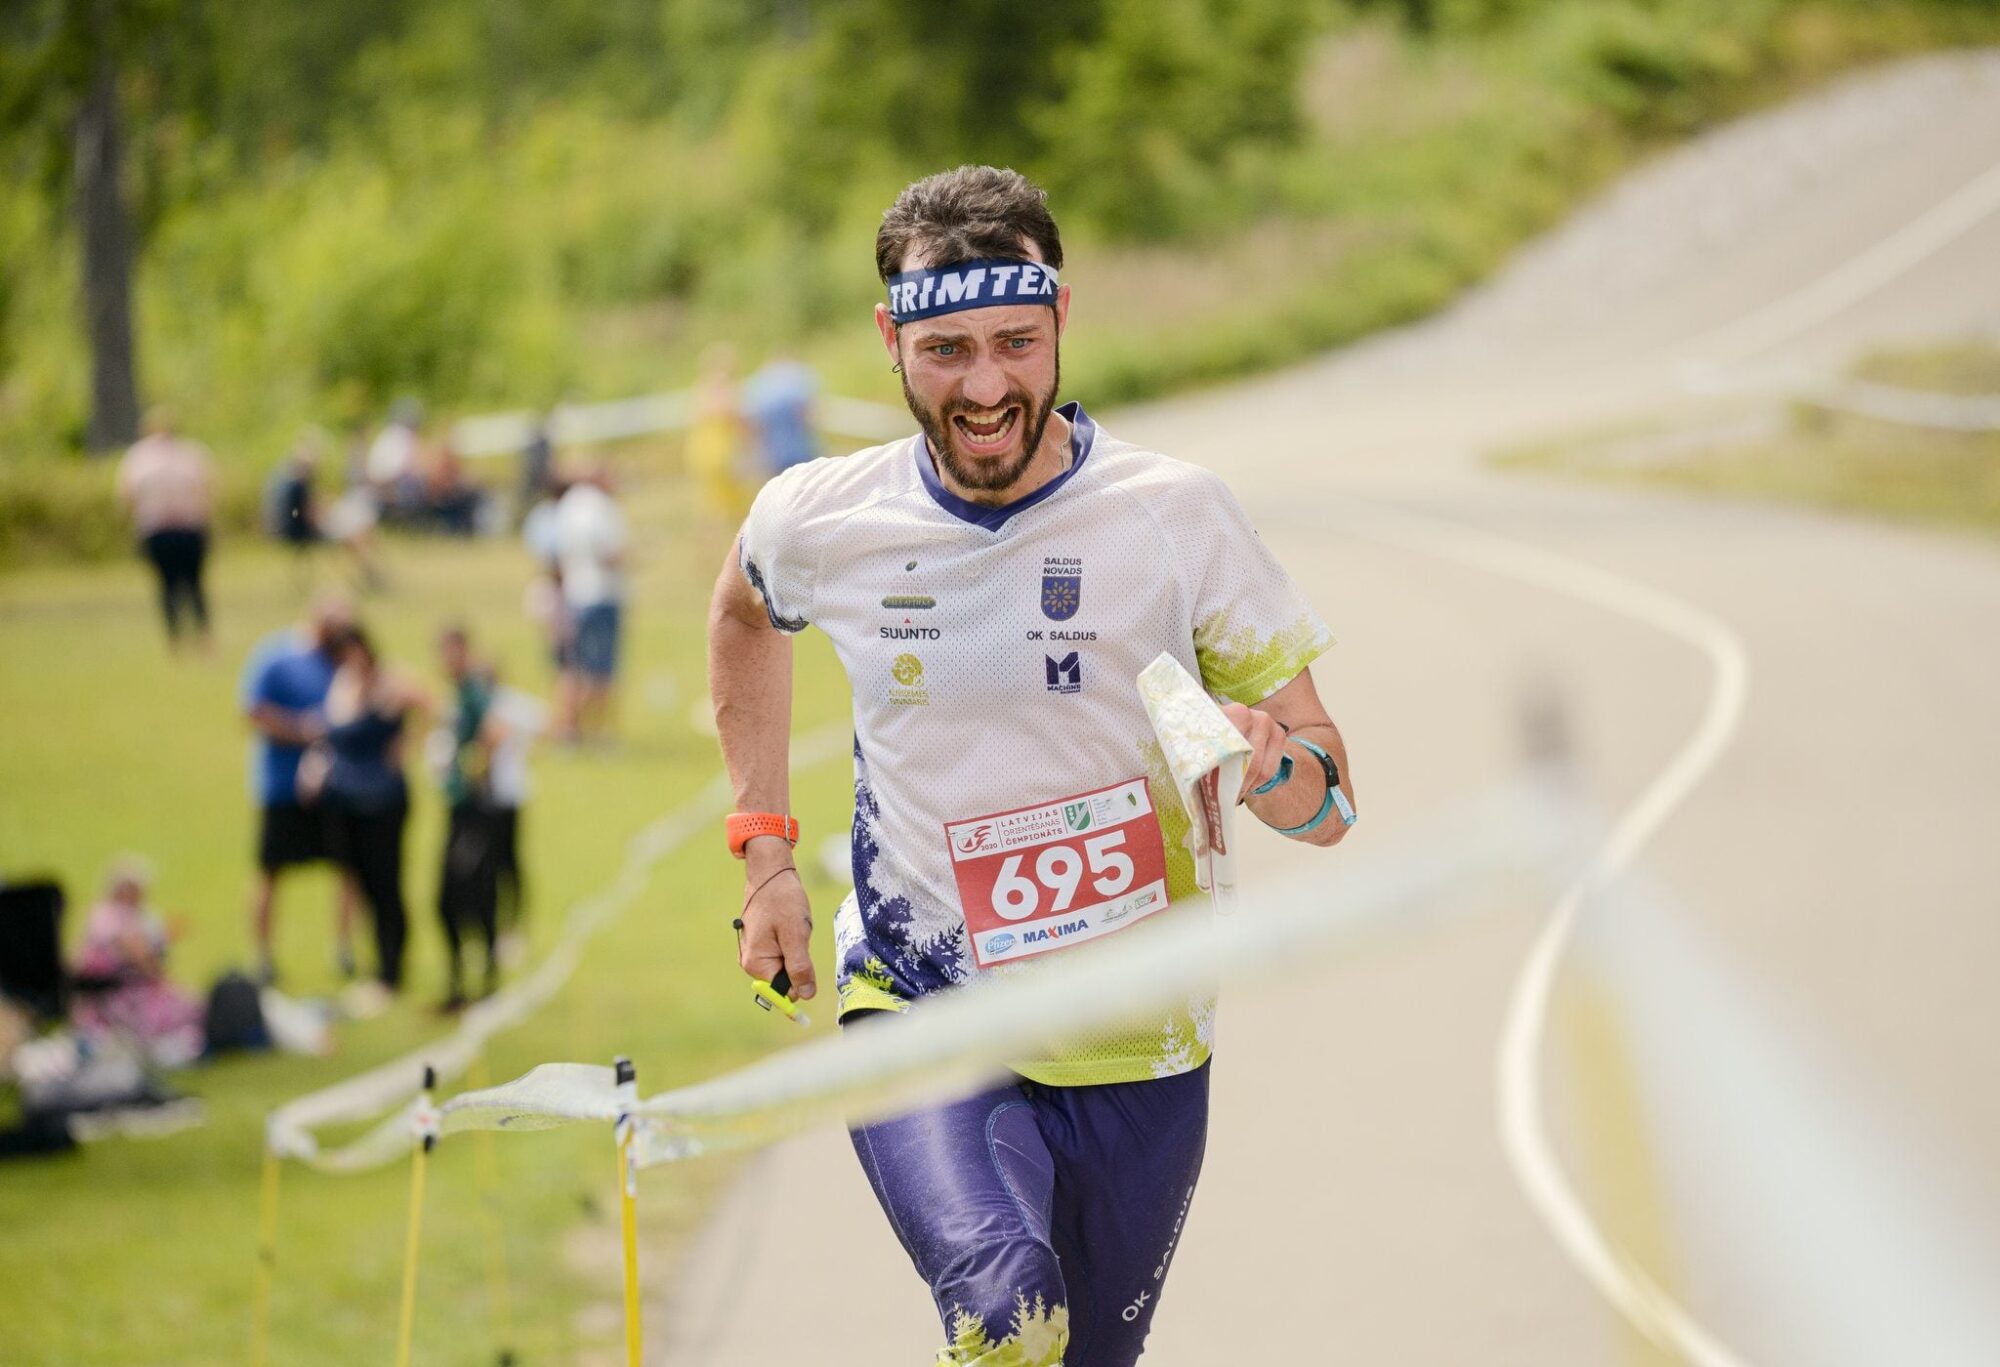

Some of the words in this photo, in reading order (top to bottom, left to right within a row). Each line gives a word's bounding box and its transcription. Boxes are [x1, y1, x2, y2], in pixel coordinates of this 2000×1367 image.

[889, 265, 1054, 315] TRIMTEX
[1043, 567, 1082, 575] NOVADS
[1044, 557, 1082, 566] SALDUS
[880, 627, 941, 641] SUUNTO
[1026, 631, 1043, 641] OK
[1050, 631, 1097, 641] SALDUS
[1001, 809, 1059, 828] LATVIJAS
[1005, 827, 1063, 846] ČEMPIONĀTS
[981, 842, 998, 851] 2020
[991, 829, 1135, 921] 695
[1023, 919, 1089, 943] MAXIMA
[987, 932, 1016, 951] Pfizer
[1121, 1290, 1151, 1322] OK
